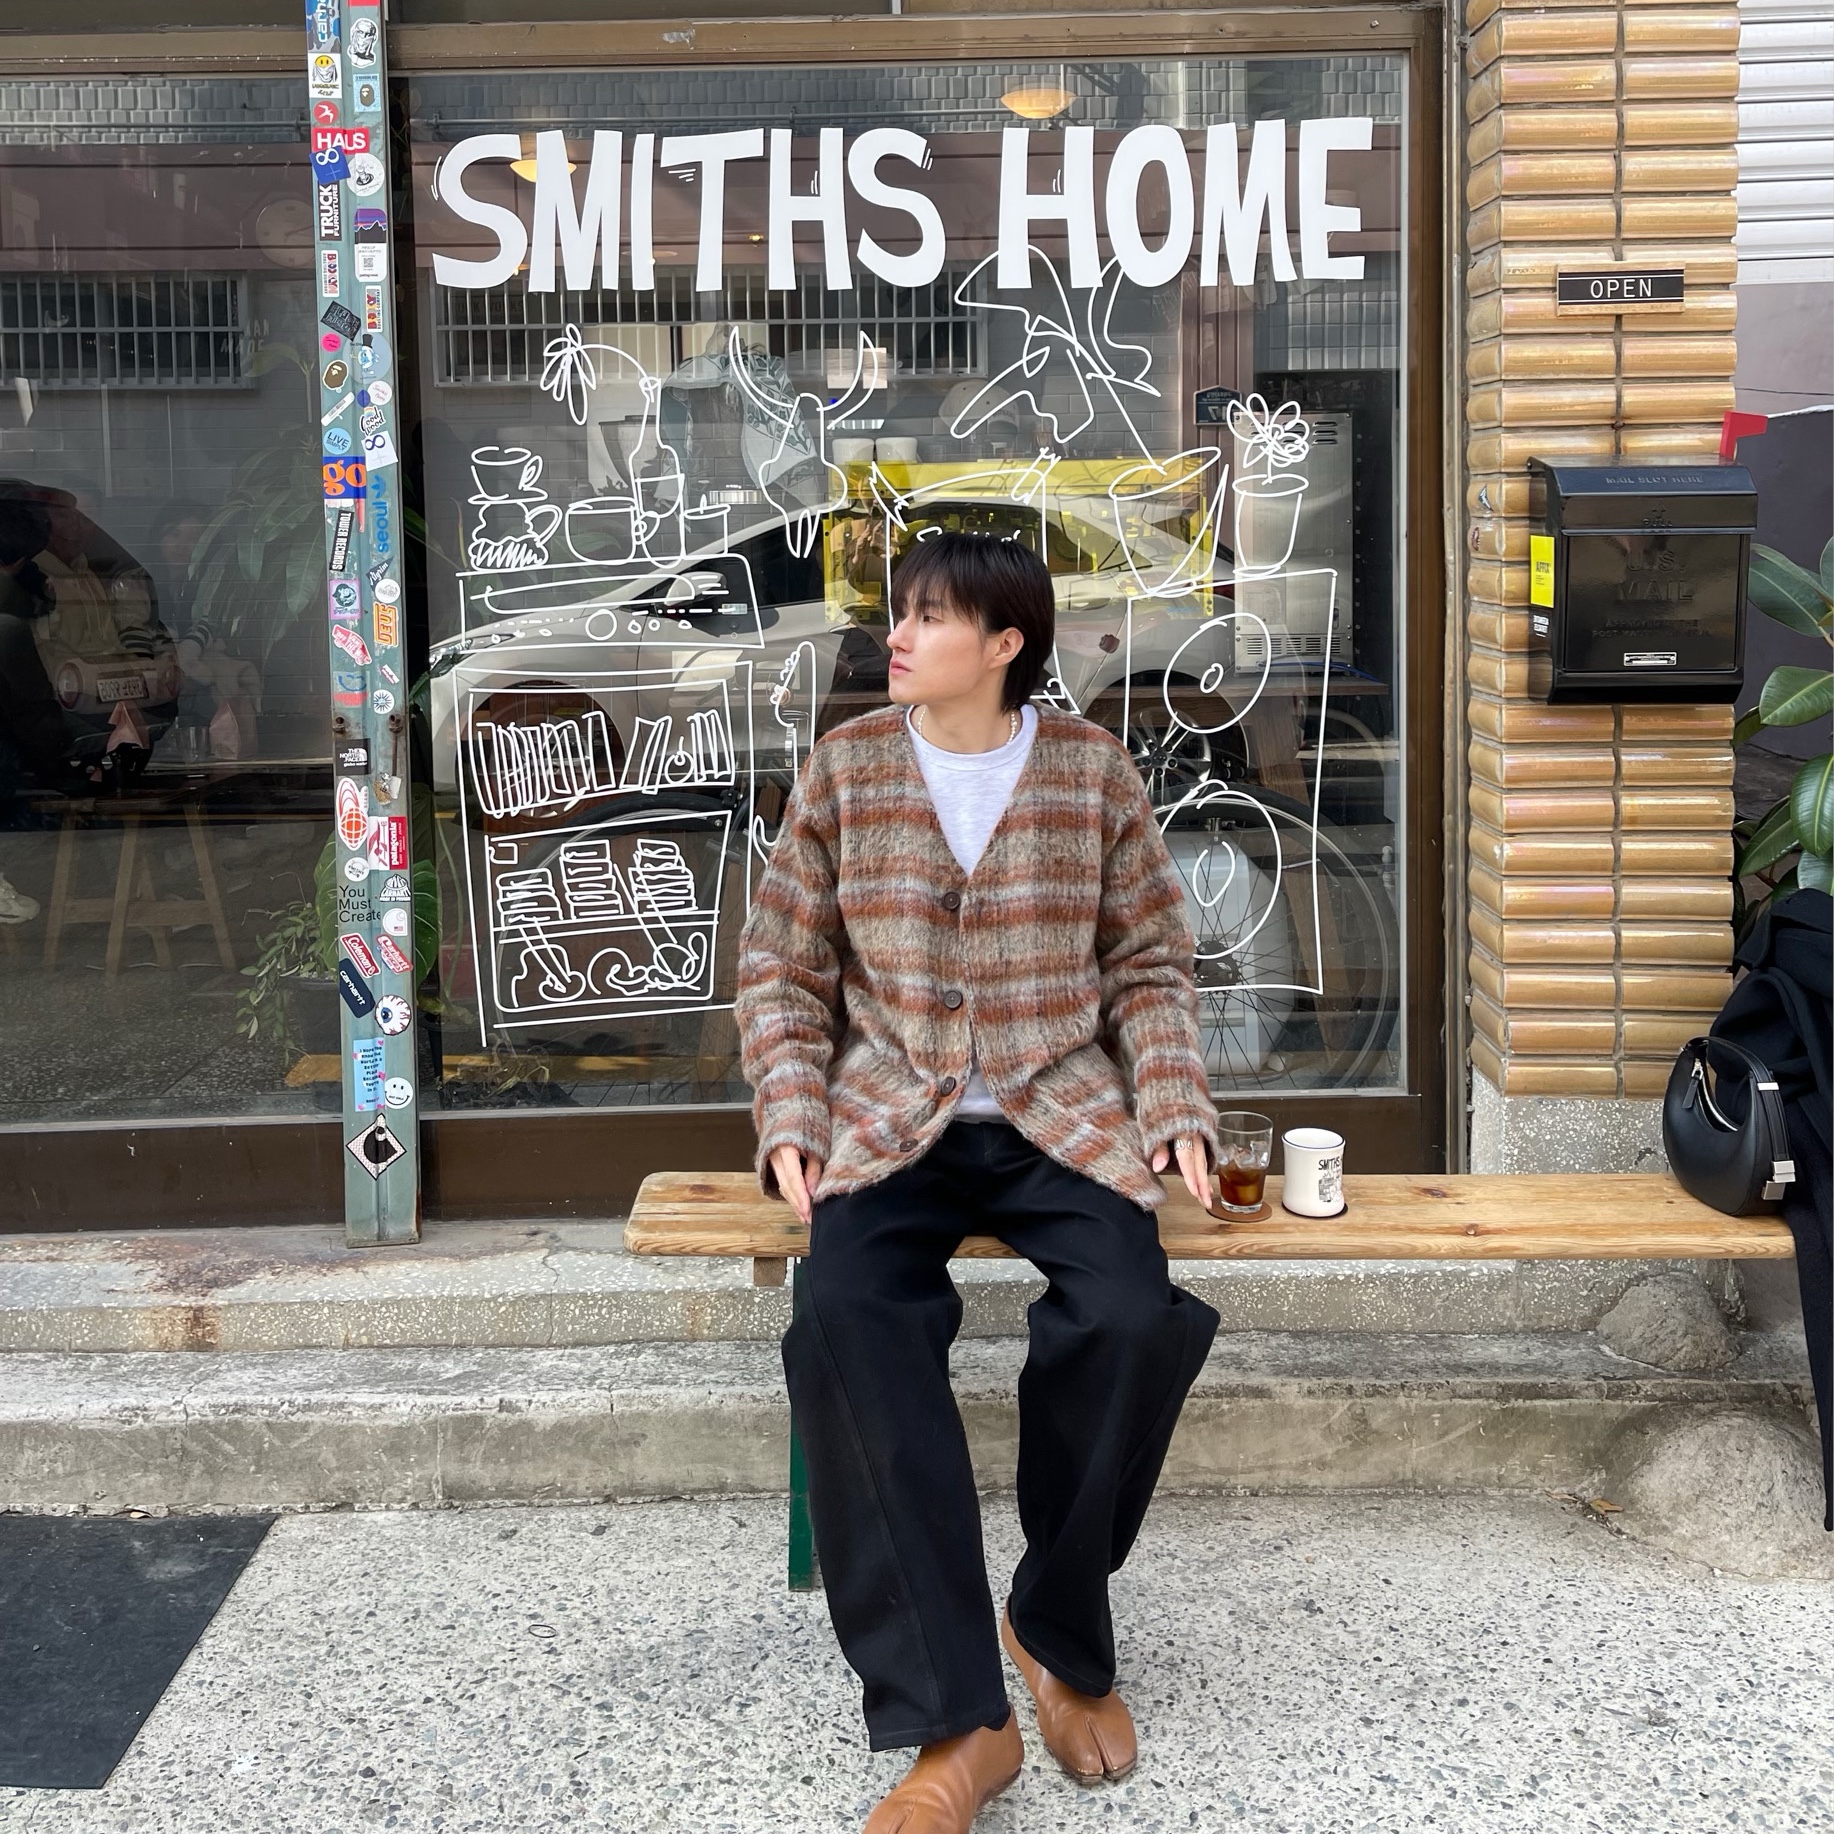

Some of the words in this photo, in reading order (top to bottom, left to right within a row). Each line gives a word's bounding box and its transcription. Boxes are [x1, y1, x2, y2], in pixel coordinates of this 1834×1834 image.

[317, 132, 366, 150] HAUS
[319, 184, 333, 237] TRUCK
[332, 184, 340, 237] FURNITURE
[433, 127, 947, 292] SMITHS
[1000, 117, 1374, 290] HOME
[1590, 278, 1652, 298] OPEN
[327, 431, 350, 447] LIVE
[323, 459, 366, 496] go
[337, 512, 352, 538] TOWER
[372, 502, 389, 553] seoul
[332, 537, 348, 571] RECORDS
[1626, 550, 1686, 572] U.S.
[1616, 579, 1693, 601] MAIL
[390, 820, 399, 865] patagonia
[339, 885, 365, 898] You
[339, 898, 371, 910] Must
[339, 910, 380, 922] Create
[348, 937, 372, 970] Coleman
[378, 936, 410, 969] Carhartt
[340, 970, 366, 1006] carhartt
